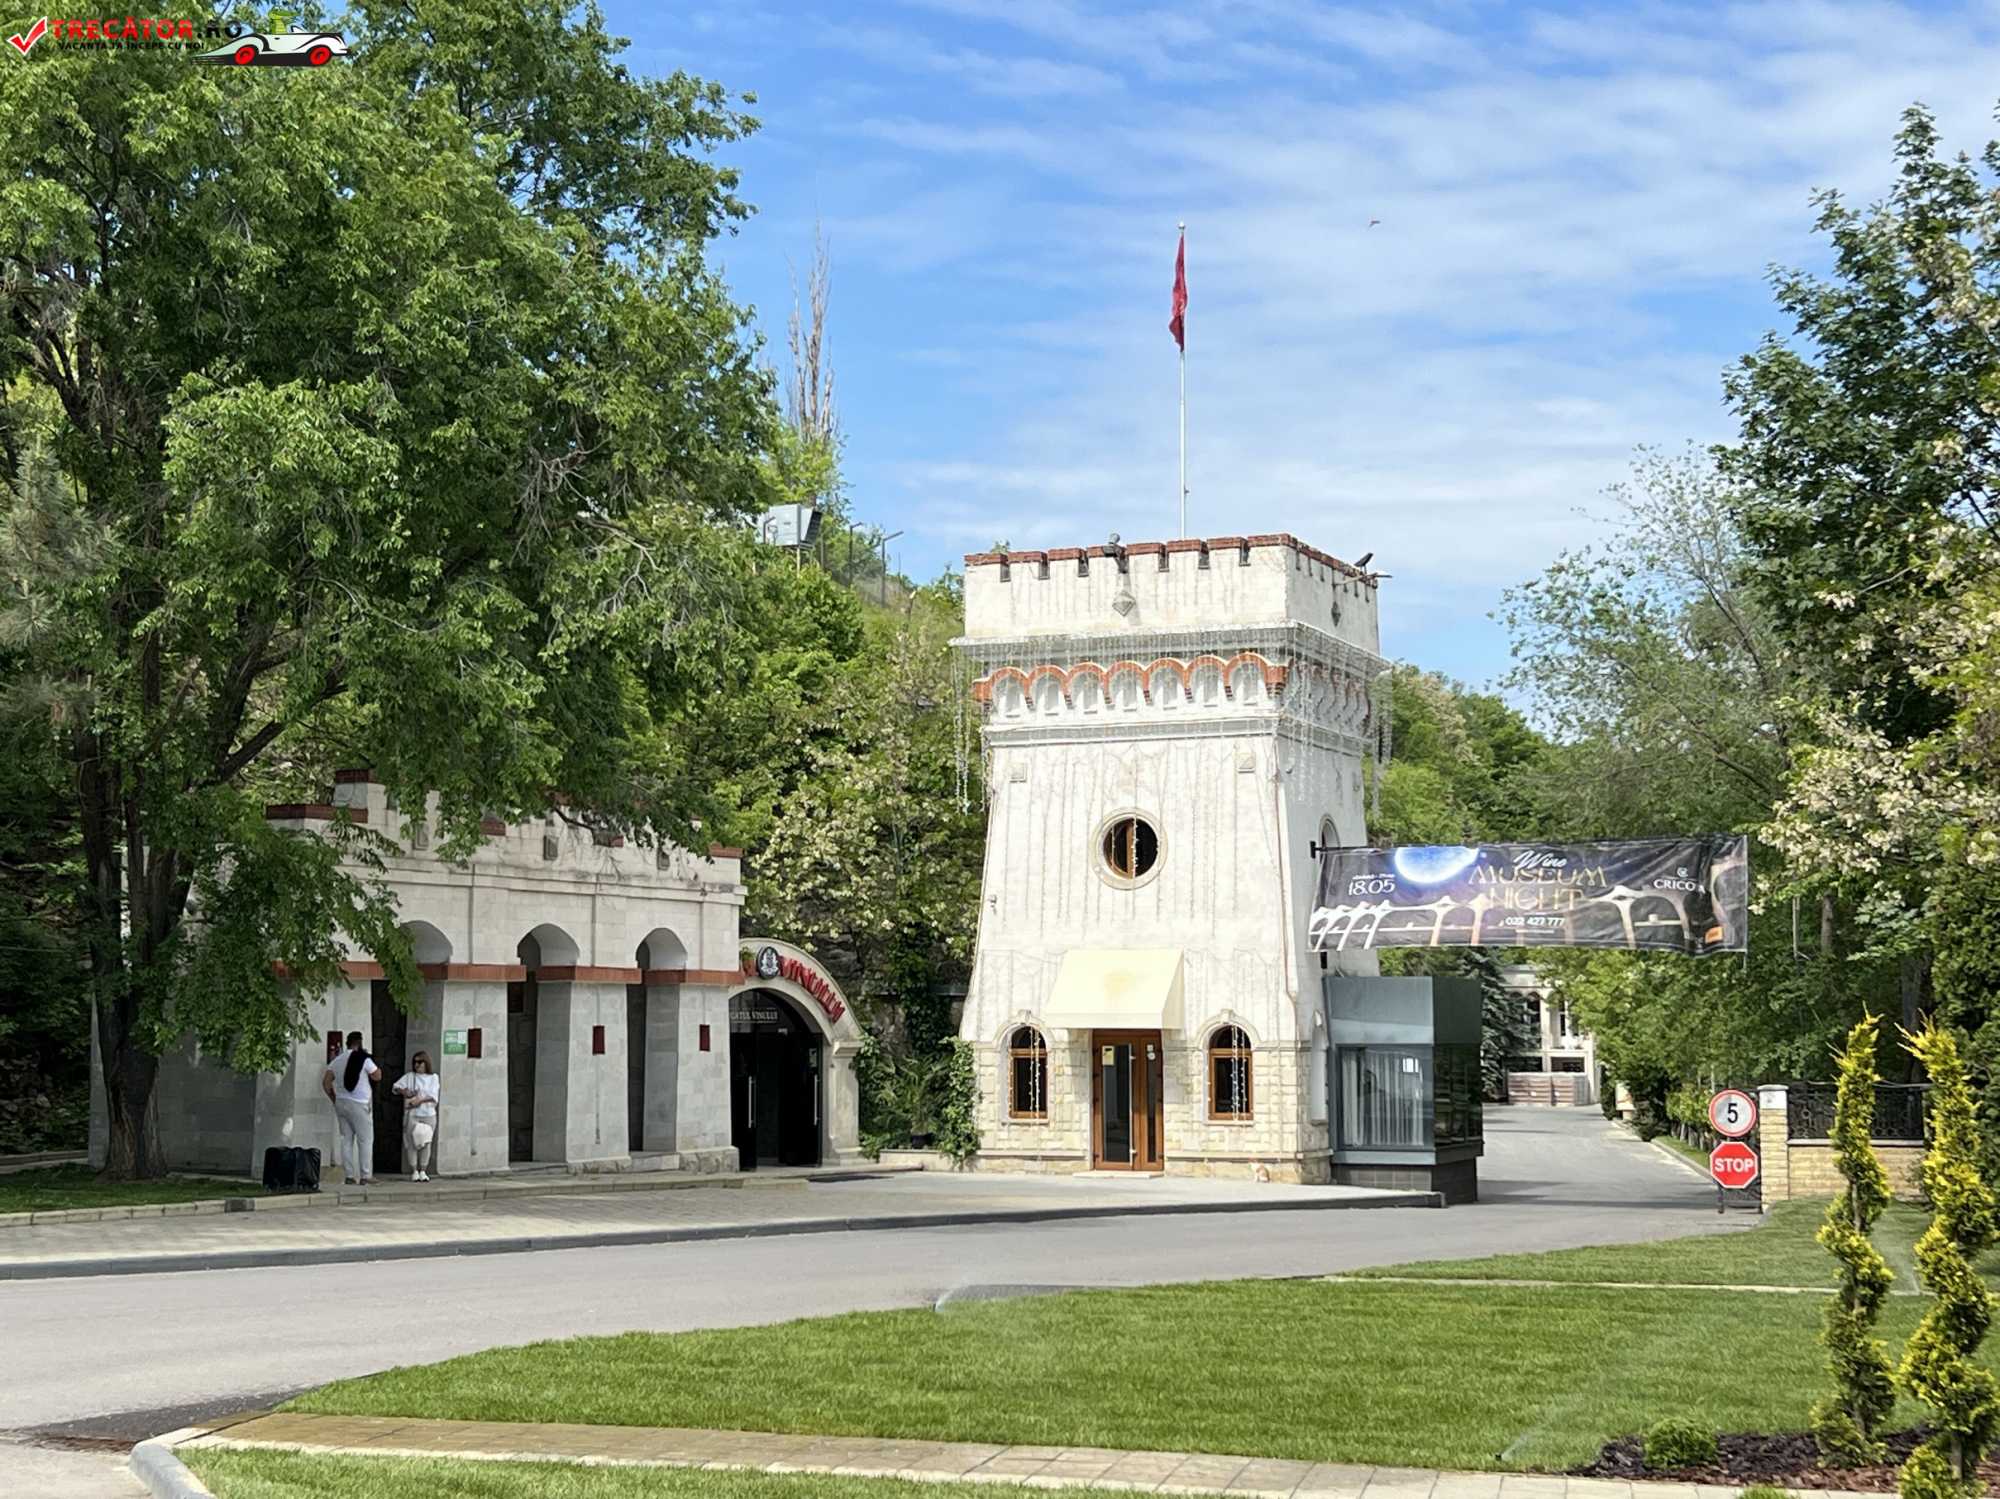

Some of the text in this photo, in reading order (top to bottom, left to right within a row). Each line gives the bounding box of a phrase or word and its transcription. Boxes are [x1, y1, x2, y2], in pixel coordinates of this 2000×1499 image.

[1513, 849, 1568, 870] Wine
[1467, 864, 1608, 888] MUSEUM
[1489, 887, 1585, 911] NIGHT
[1727, 1102, 1738, 1124] 5
[1714, 1157, 1754, 1173] STOP
